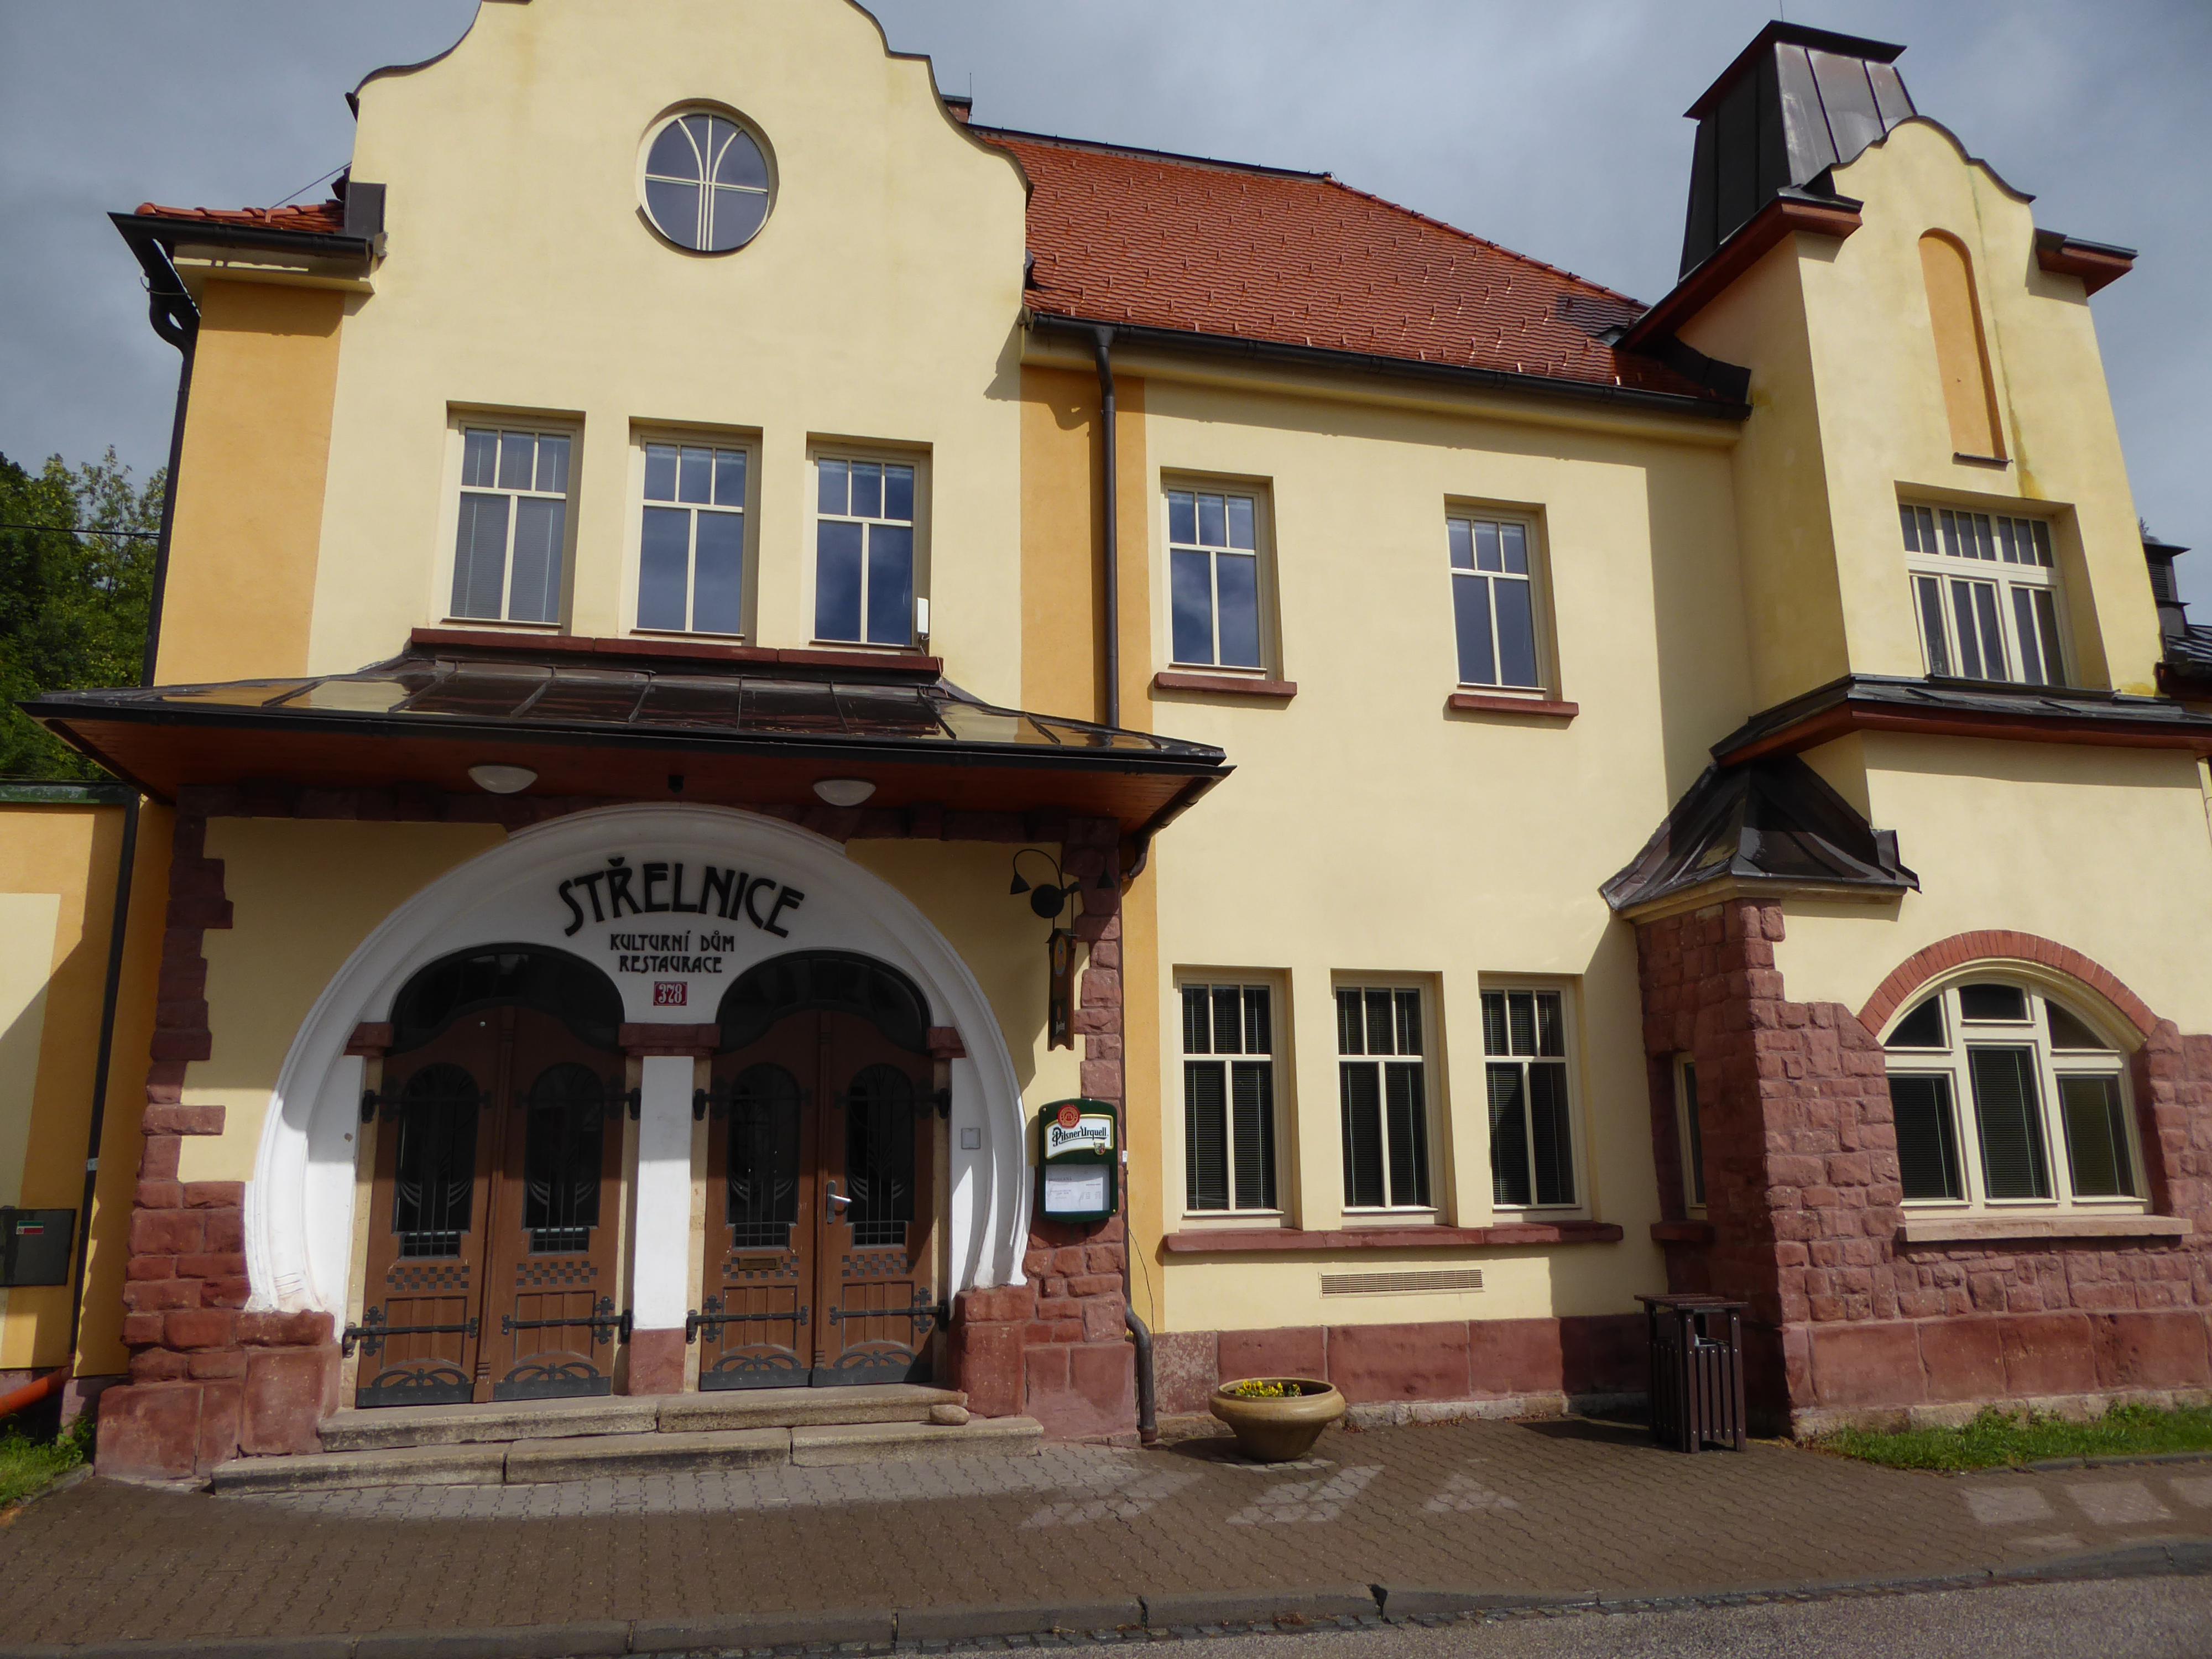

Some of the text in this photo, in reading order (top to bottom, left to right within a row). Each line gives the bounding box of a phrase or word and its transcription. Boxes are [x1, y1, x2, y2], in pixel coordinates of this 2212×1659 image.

[558, 855, 805, 938] STŘELNICE
[610, 930, 735, 952] KULTURNÍ DŮM
[619, 955, 722, 973] RESTAURACE
[658, 983, 682, 1004] 378
[1052, 1126, 1107, 1147] Pilsner Urquell
